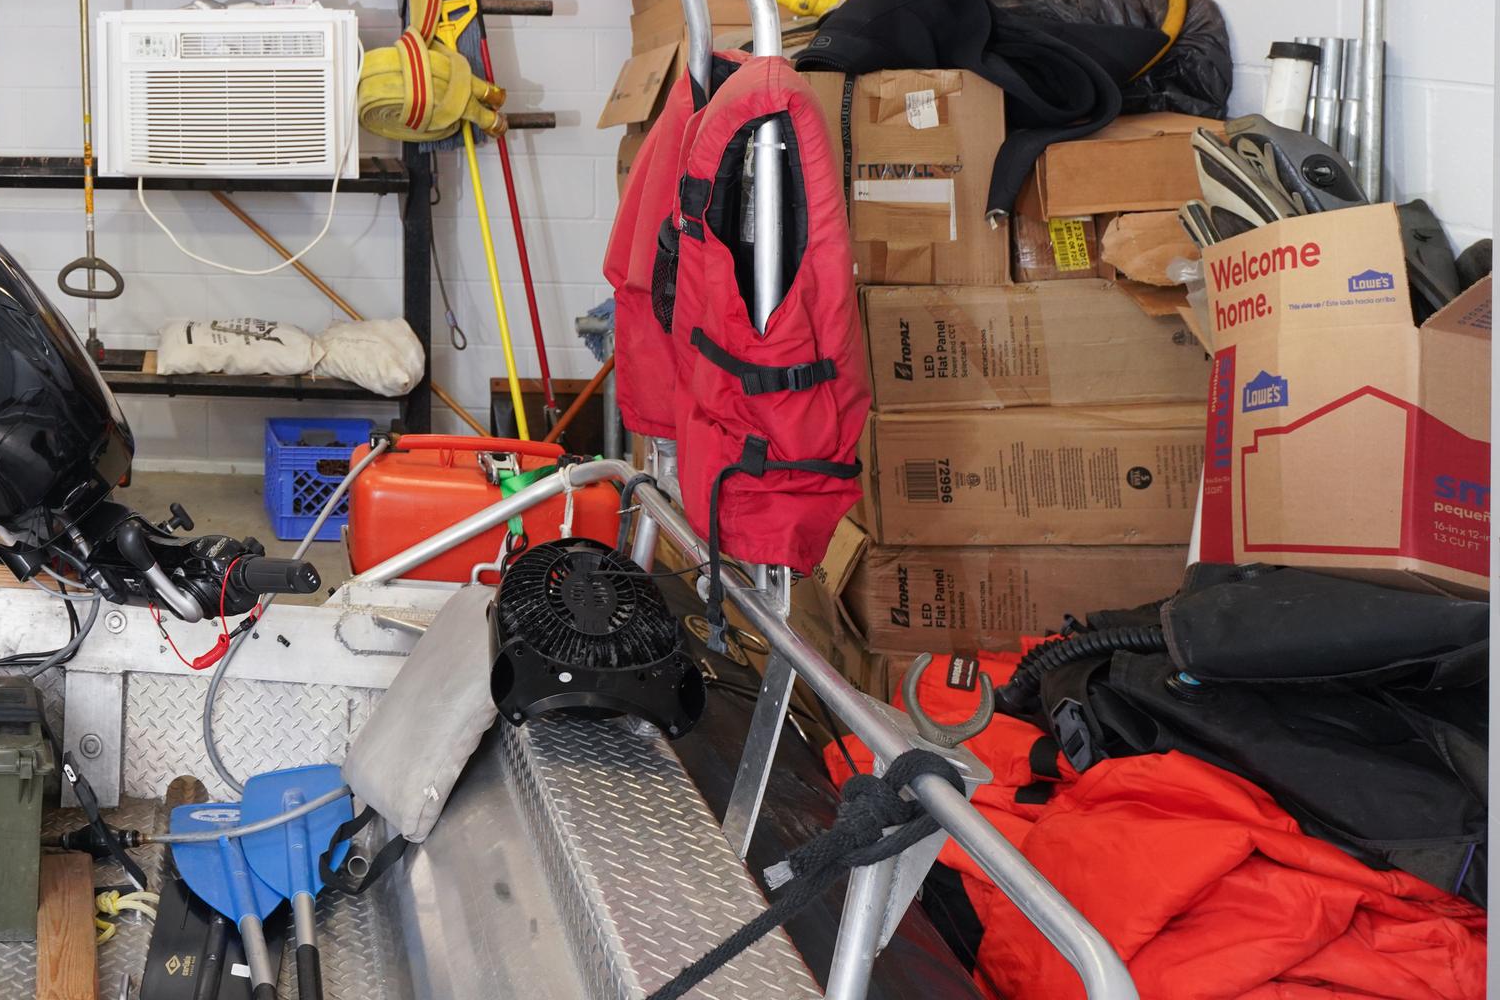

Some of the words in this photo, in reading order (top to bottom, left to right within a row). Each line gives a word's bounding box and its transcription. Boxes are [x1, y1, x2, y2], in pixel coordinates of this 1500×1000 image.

[1210, 241, 1320, 292] Welcome
[1215, 295, 1272, 332] home.
[1326, 300, 1339, 308] Este
[1339, 299, 1354, 307] lado
[1355, 298, 1374, 306] hacia
[1375, 296, 1396, 305] arriba
[899, 320, 912, 363] TOPAZ
[934, 320, 947, 353] Panel
[949, 340, 957, 355] and
[924, 355, 936, 379] LED
[937, 356, 949, 379] Flat
[950, 356, 959, 378] Power
[959, 341, 969, 378] Selectable
[1245, 383, 1282, 408] LOWE'S
[1214, 357, 1232, 469] small
[938, 458, 952, 504] 72996
[1434, 521, 1458, 534] 16-in
[1449, 535, 1465, 548] CU
[1466, 540, 1481, 551] FT
[897, 566, 910, 610] TOPAZ
[933, 568, 946, 602] Panel
[947, 590, 956, 604] and
[921, 603, 933, 628] LED
[935, 605, 947, 628] Flat
[948, 606, 958, 629] Power
[957, 591, 967, 629] Selectable
